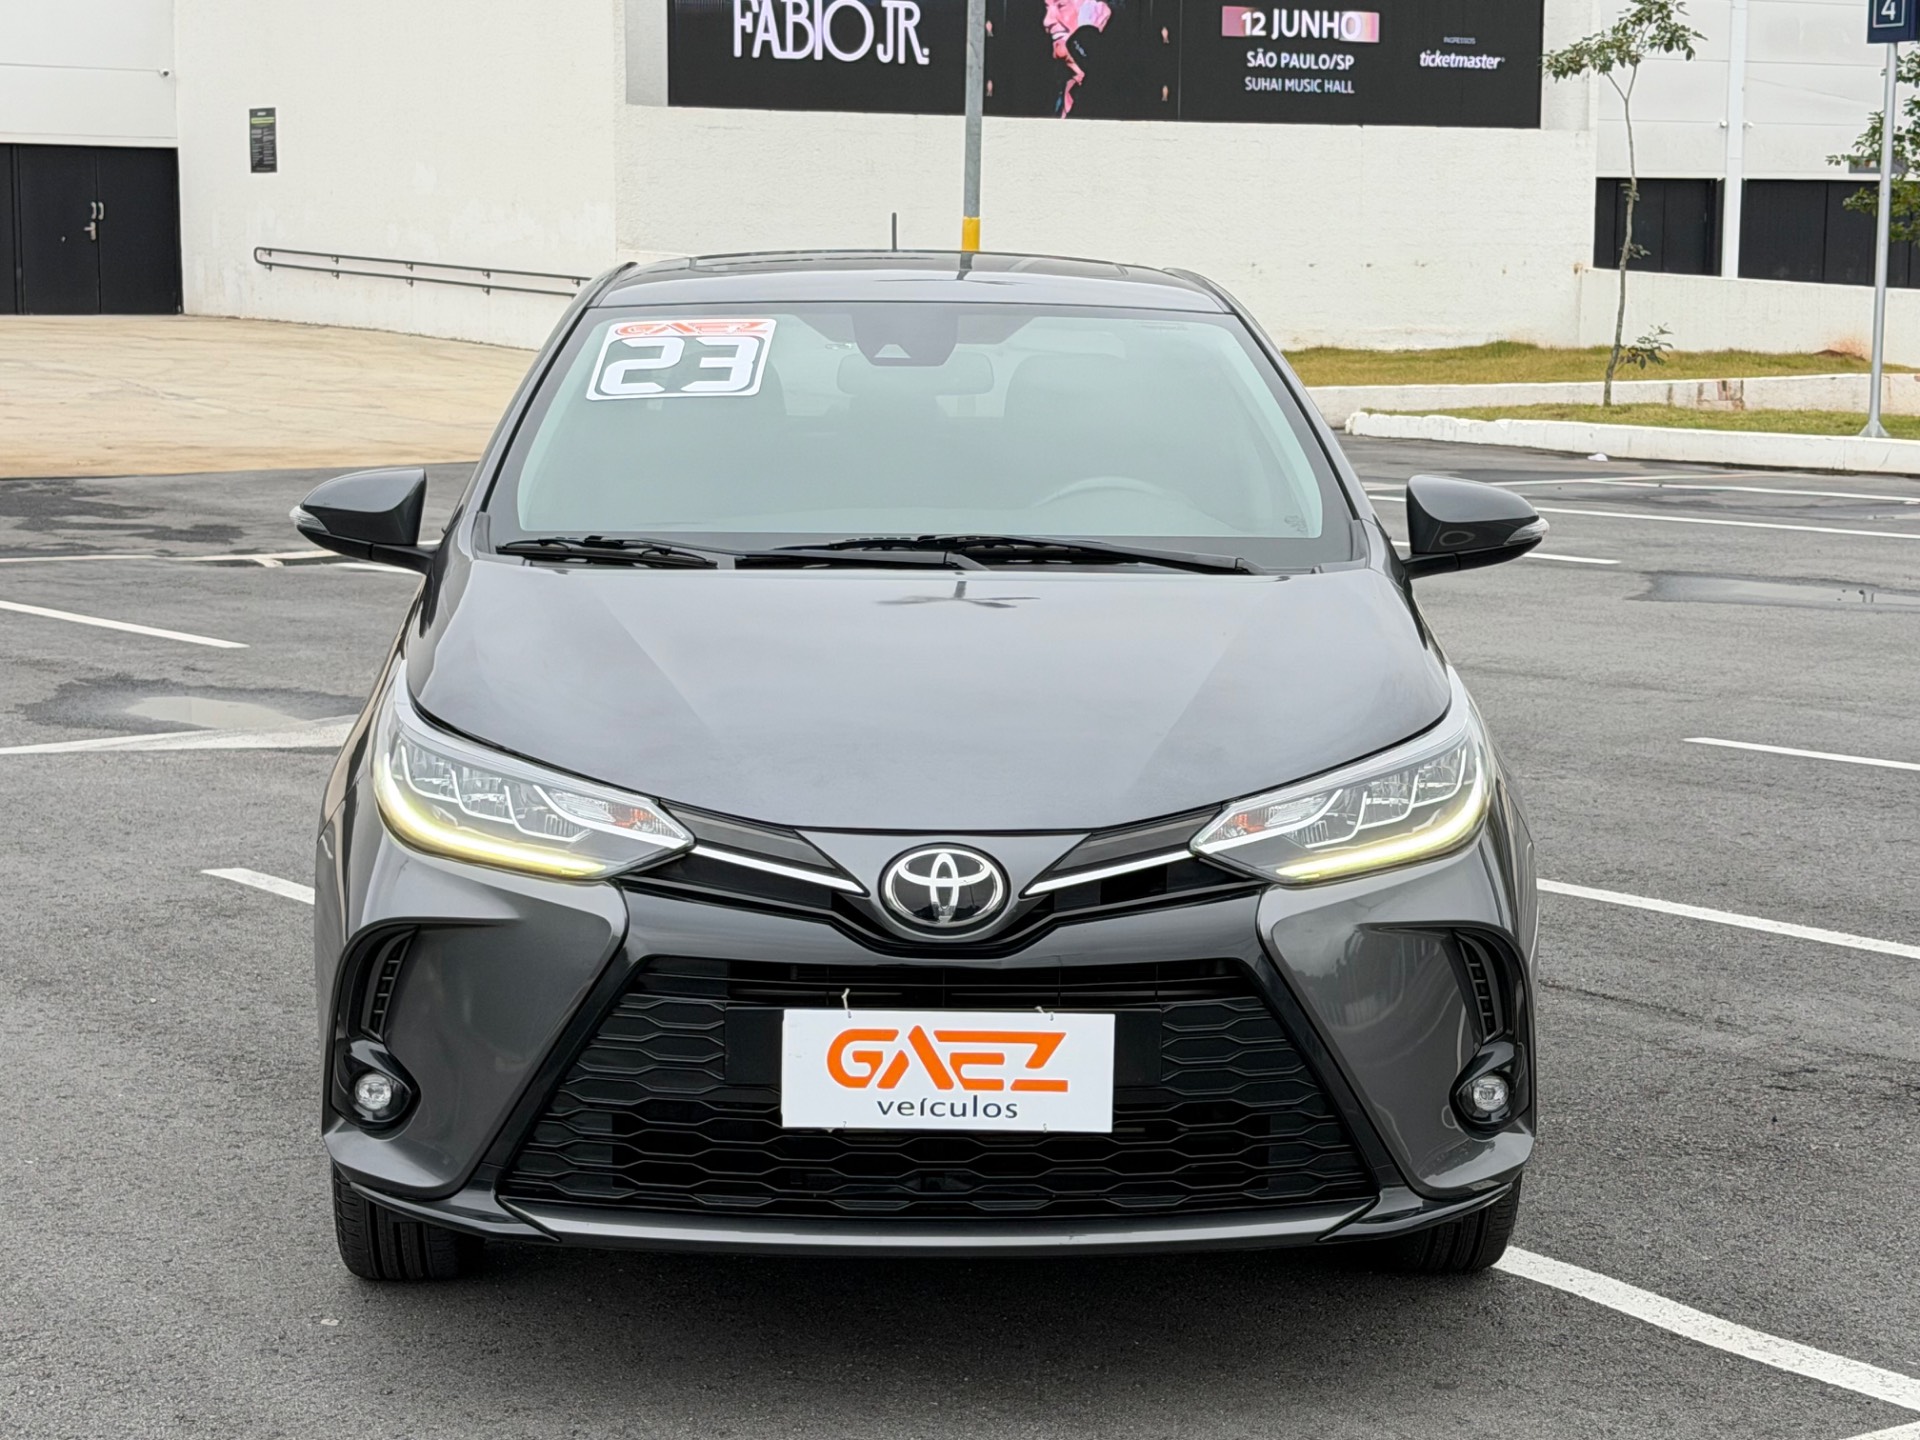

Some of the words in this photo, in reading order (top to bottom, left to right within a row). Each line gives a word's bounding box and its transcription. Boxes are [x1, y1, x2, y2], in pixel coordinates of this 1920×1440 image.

[1880, 0, 1896, 20] 4
[876, 0, 930, 65] JR.
[1241, 11, 1267, 36] 12
[1271, 8, 1362, 40] JUNHO
[1246, 48, 1278, 68] SÃO
[1280, 52, 1355, 70] PAULO/SP
[1419, 50, 1501, 69] ticketmaster
[1244, 76, 1282, 91] SUHAI
[1284, 78, 1322, 93] MUSIC
[1324, 79, 1355, 94] HALL
[600, 336, 760, 394] 23
[827, 1025, 1069, 1092] GAEZ
[876, 1095, 1018, 1119] veículos
